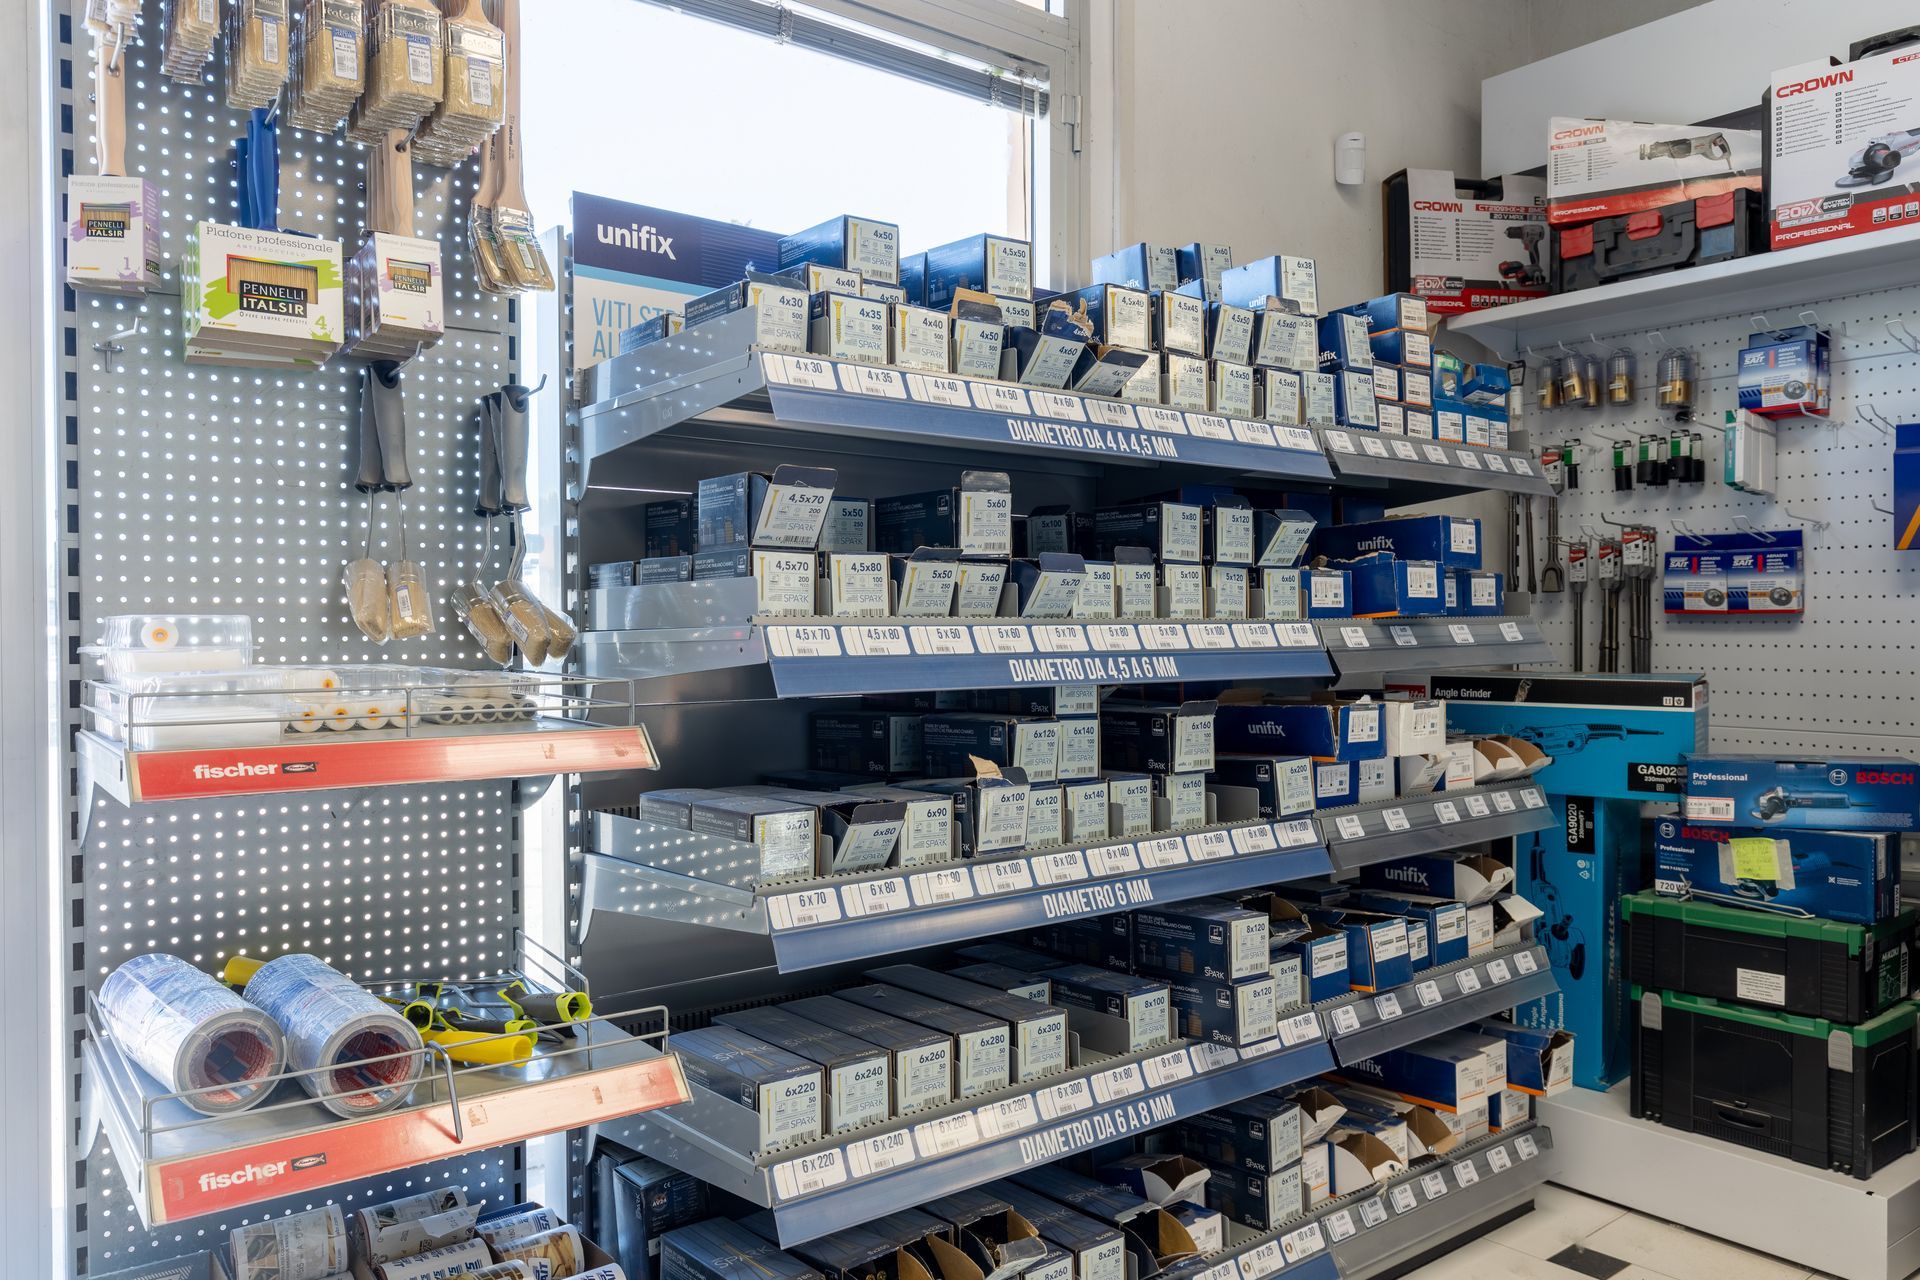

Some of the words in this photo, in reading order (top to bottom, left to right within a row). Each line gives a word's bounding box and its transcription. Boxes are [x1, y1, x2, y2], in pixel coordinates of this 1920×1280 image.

[1776, 69, 1854, 99] CROWN
[1554, 125, 1604, 140] CROWN
[1413, 201, 1463, 213] CROWN
[1553, 205, 1608, 216] PROFESSIONAL
[88, 220, 124, 228] PENNELLI
[88, 229, 123, 237] ITALSIR
[873, 229, 893, 241] 4x50
[1775, 222, 1855, 241] PROFESSIONAL
[206, 226, 252, 241] Plafone
[256, 235, 333, 253] professionale
[597, 222, 677, 261] unifix
[1002, 246, 1027, 259] 4,5x50
[1159, 247, 1174, 256] 6x38
[1214, 247, 1228, 255] 6x60
[871, 256, 893, 268] SPARK
[1296, 261, 1313, 270] 6x38
[394, 274, 426, 285] PENNELLI
[835, 277, 856, 289] 4x40
[243, 283, 304, 300] PENNELLI
[394, 282, 426, 293] ITALSIR
[779, 296, 803, 308] 4x30
[879, 293, 899, 304] 4x50
[1121, 296, 1145, 308] 4,5x40
[243, 297, 305, 315] ITALSIR
[1005, 306, 1030, 317] 4,5x50
[1177, 302, 1199, 313] 4,5x45
[592, 297, 632, 329] VITI
[859, 308, 882, 320] 4x35
[315, 315, 328, 330] 4
[922, 318, 944, 330] 4x40
[1231, 314, 1250, 325] 4,5x50
[1276, 320, 1297, 329] 4,5x60
[871, 323, 882, 331] 500
[979, 330, 999, 341] 4x50
[858, 339, 882, 351] SPARK
[1058, 345, 1078, 356] 4x60
[795, 360, 802, 371] 4
[810, 361, 823, 374] 30
[975, 360, 996, 370] SPARK
[867, 369, 874, 381] 4
[881, 371, 893, 383] 35
[1111, 369, 1131, 378] 4x70
[1229, 369, 1250, 380] 4,5x50
[1278, 378, 1297, 388] 4,5x60
[1317, 375, 1332, 384] 6x38
[1357, 376, 1371, 385] 6x60
[1007, 418, 1082, 448] DIAMETRO
[1085, 430, 1105, 450] DA
[1106, 432, 1117, 451] 4
[1119, 432, 1130, 452] A
[1130, 434, 1153, 456] 4,5
[1154, 437, 1178, 458] MM
[788, 493, 825, 505] 4,5x70
[986, 499, 1007, 509] 5x60
[842, 508, 864, 518] 5x50
[1181, 511, 1197, 521] 5x80
[1041, 519, 1062, 529] 5x100
[1231, 514, 1250, 524] 5x120
[787, 522, 816, 532] SPARK
[1357, 536, 1394, 551] unifix
[775, 561, 809, 572] 4,5x70
[850, 562, 882, 573] 4,5x80
[932, 570, 953, 580] 5x50
[980, 573, 1000, 583] 5x60
[1093, 571, 1111, 581] 5x80
[1135, 571, 1151, 580] 5x90
[1180, 570, 1200, 580] 5x100
[1225, 573, 1244, 582] 5x120
[1281, 574, 1296, 583] 6x60
[1060, 578, 1081, 587] 5x70
[859, 593, 884, 603] SPARK
[795, 628, 810, 641] 4,5
[818, 628, 831, 641] 70
[1008, 658, 1084, 682] DIAMETRO
[1087, 658, 1107, 680] DA
[1108, 658, 1130, 682] 4,5
[1131, 658, 1142, 678] A
[1142, 657, 1152, 678] 6
[1154, 656, 1179, 678] MM
[1434, 687, 1459, 699] Angle
[1460, 688, 1492, 699] Grinder
[1073, 726, 1095, 736] 6x140
[1191, 720, 1212, 731] 6x160
[1248, 721, 1286, 737] unifix
[193, 762, 278, 780] fischer
[1290, 764, 1308, 775] 6x200
[1692, 772, 1748, 783] Professional
[1855, 771, 1914, 785] BOSCH
[1182, 779, 1202, 789] 6x160
[1083, 790, 1105, 800] 6x140
[1127, 785, 1148, 795] 6x150
[1000, 792, 1026, 803] 6x100
[1035, 795, 1058, 806] 6x120
[926, 807, 947, 818] 6x90
[1567, 803, 1578, 844] GA9020
[872, 826, 896, 838] 6x80
[1681, 827, 1730, 843] BOSCH
[925, 839, 947, 849] SPARK
[1384, 867, 1429, 887] unifix
[1660, 881, 1675, 890] 720
[799, 894, 806, 907] 6
[815, 891, 827, 905] 70
[1041, 885, 1115, 919] DIAMETRO
[1116, 883, 1126, 904] 6
[1128, 878, 1154, 902] MM
[1246, 923, 1266, 934] 8x120
[1280, 964, 1298, 976] 8x160
[1028, 989, 1046, 1000] 8x80
[1252, 986, 1272, 998] 8x120
[1144, 997, 1166, 1009] 8x100
[1037, 1022, 1062, 1036] 6x300
[980, 1034, 1005, 1047] 6x280
[919, 1049, 946, 1064] 6x260
[854, 1066, 883, 1082] 6x240
[785, 1081, 816, 1098] 6x220
[790, 1115, 817, 1129] SPARK
[1282, 1113, 1298, 1128] 6x110
[1019, 1120, 1095, 1165] DIAMETRO
[1096, 1115, 1117, 1141] DA
[1117, 1111, 1127, 1133] 6
[1128, 1108, 1140, 1129] A
[1141, 1105, 1151, 1126] 8
[1151, 1093, 1177, 1121] MM
[802, 1159, 809, 1173] 6
[817, 1152, 835, 1169] 220
[198, 1161, 287, 1192] fischer
[1282, 1173, 1299, 1187] 6x110
[1098, 1245, 1120, 1261] 8x280
[1044, 1266, 1068, 1280] 8x260
